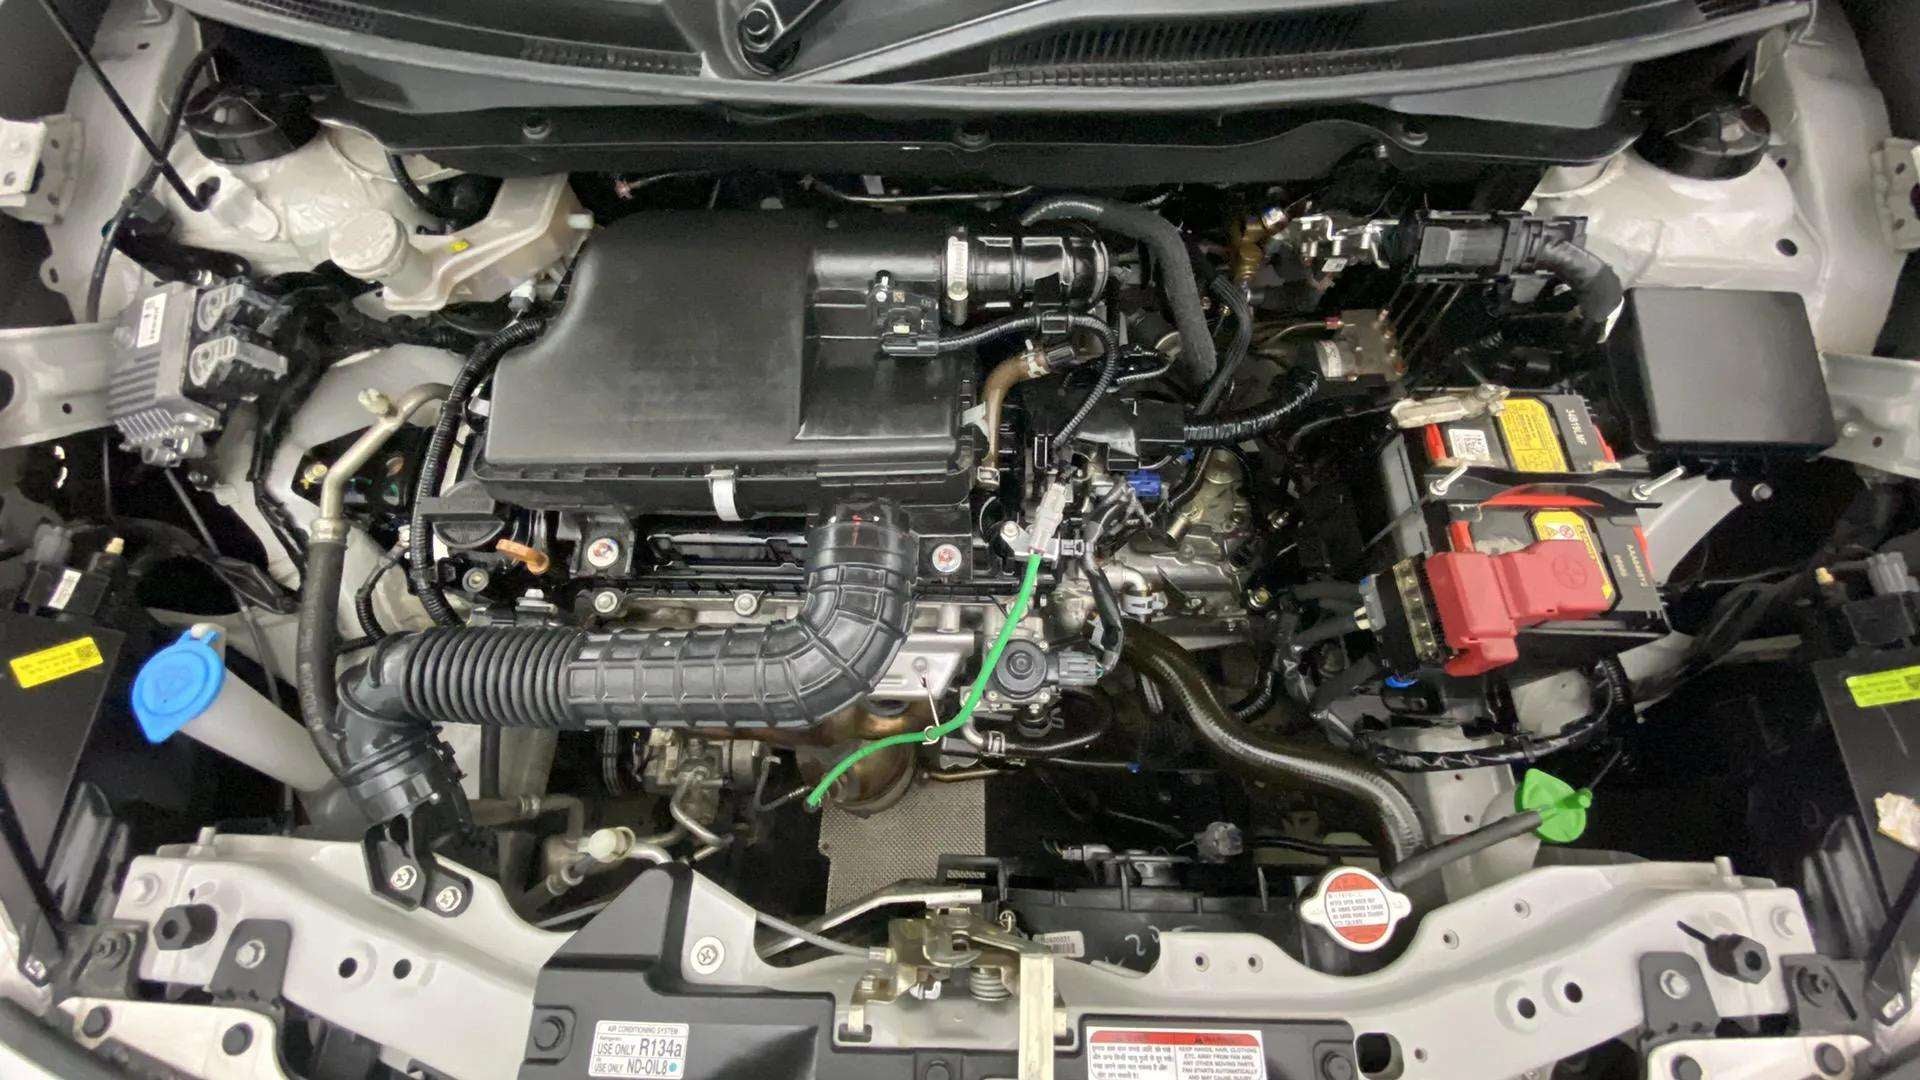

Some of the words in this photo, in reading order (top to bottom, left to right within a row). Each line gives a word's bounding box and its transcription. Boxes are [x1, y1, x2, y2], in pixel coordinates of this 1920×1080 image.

[597, 1043, 613, 1055] USE
[615, 1043, 636, 1056] ONLY
[639, 1037, 682, 1057] R134a
[594, 1063, 606, 1073] USE
[607, 1063, 624, 1073] ONLY
[626, 1058, 668, 1075] ND-OIL8
